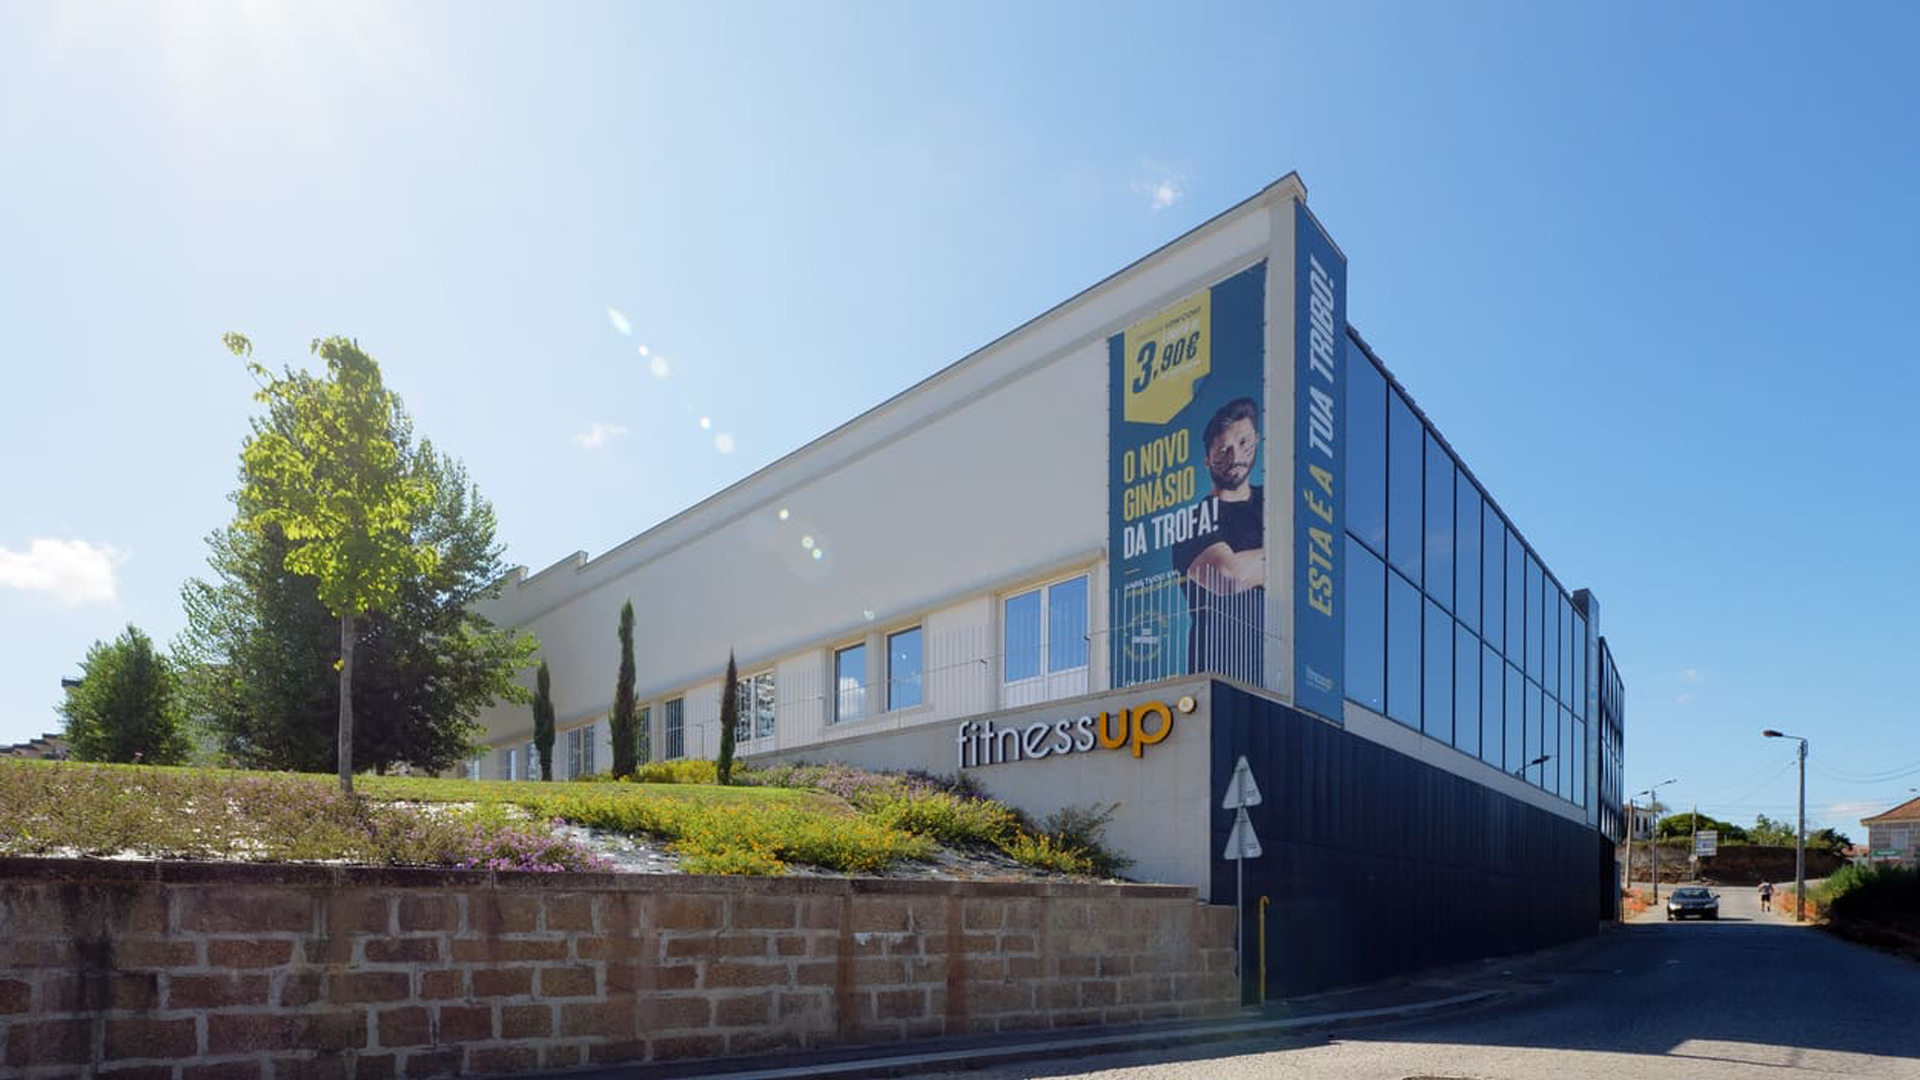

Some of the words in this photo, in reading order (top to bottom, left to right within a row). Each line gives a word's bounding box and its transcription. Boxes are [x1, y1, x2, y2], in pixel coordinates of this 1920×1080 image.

[1309, 253, 1335, 384] TRIBO!
[1309, 386, 1334, 460] TUA
[1123, 450, 1135, 484] O
[1140, 428, 1189, 479] NOVO
[1308, 464, 1334, 498] A
[1123, 465, 1195, 522] GINÁSIO
[1303, 488, 1333, 525] É
[1123, 522, 1147, 560] DA
[1151, 496, 1220, 550] TROFA!
[1308, 527, 1333, 617] ESTA
